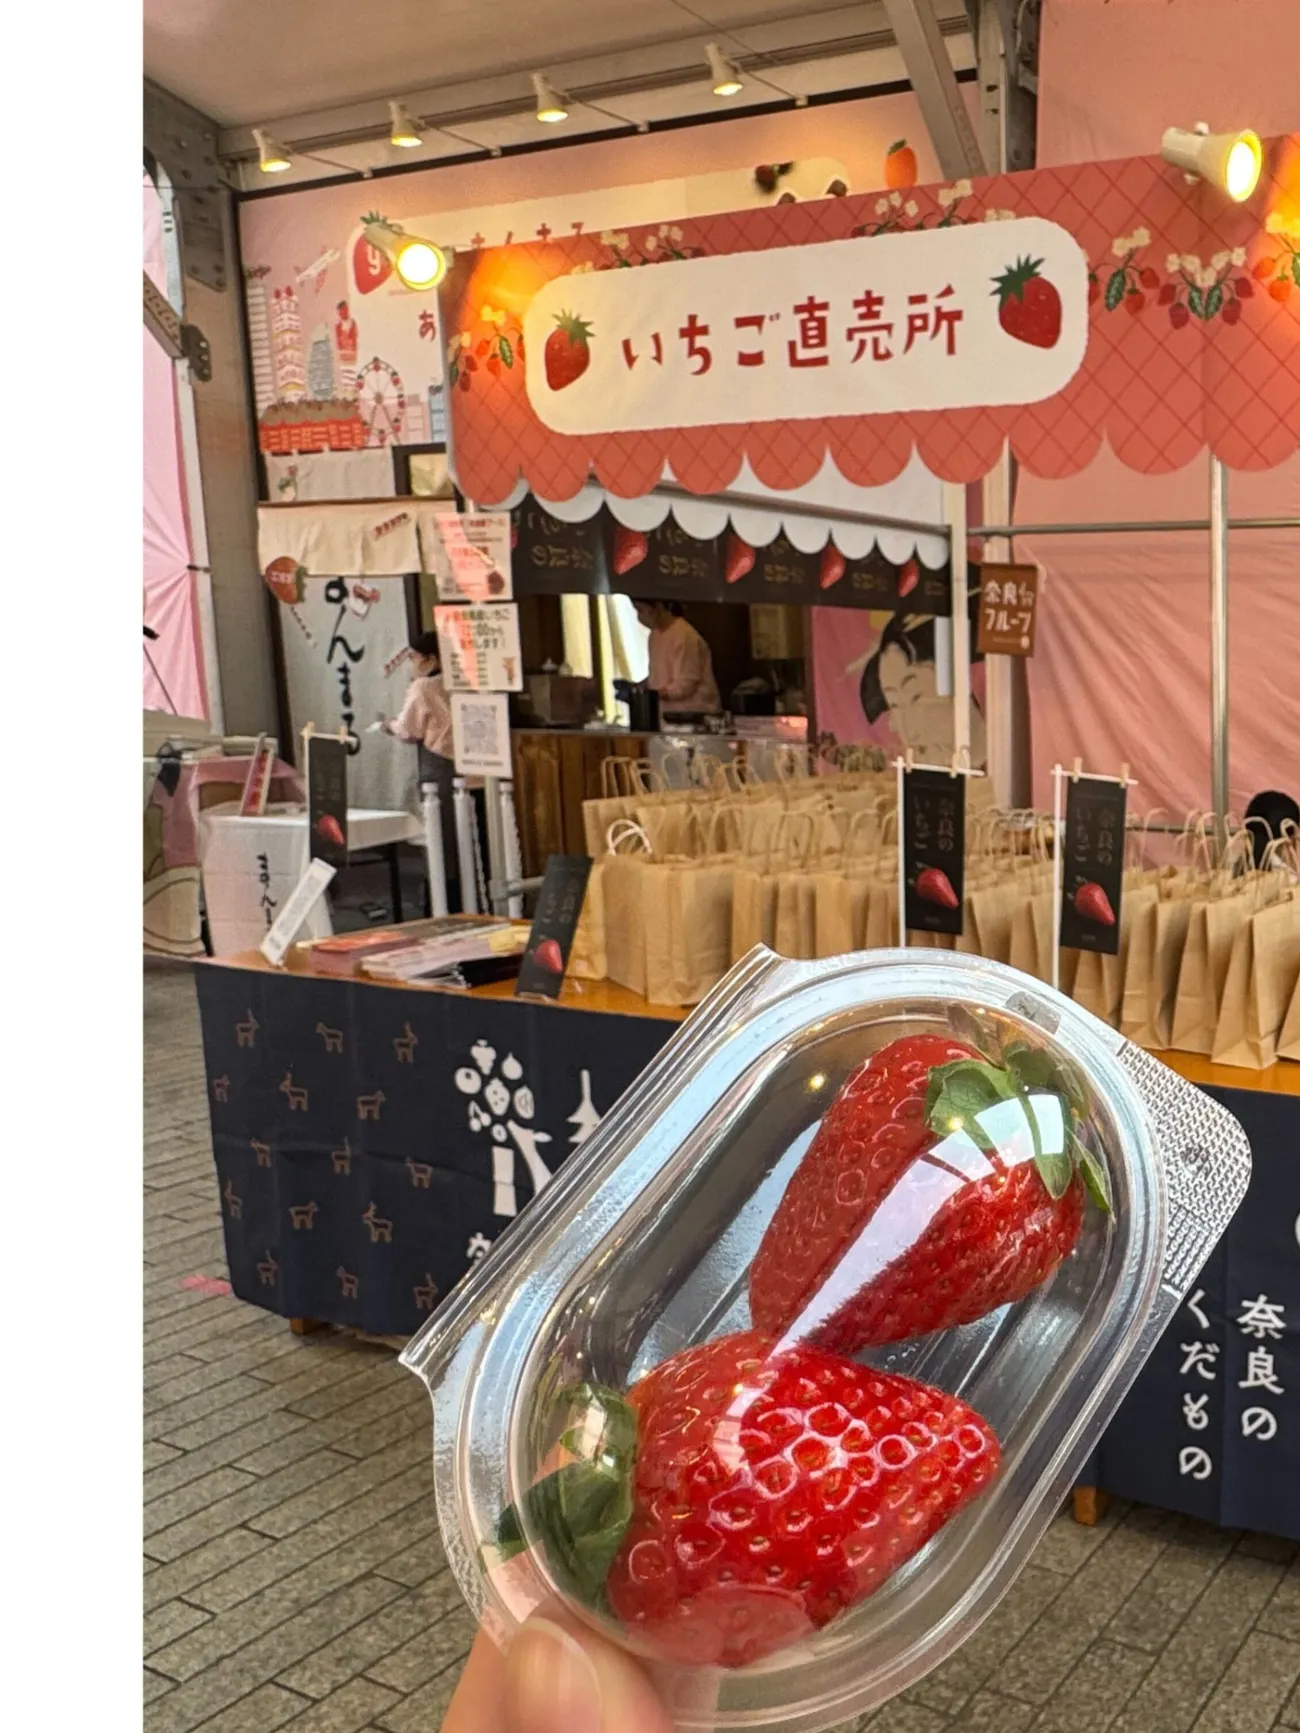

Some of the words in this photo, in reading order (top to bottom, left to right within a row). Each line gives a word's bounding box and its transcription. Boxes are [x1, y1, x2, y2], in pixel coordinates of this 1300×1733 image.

[418, 308, 437, 342] あ
[622, 283, 964, 376] いちご直売所
[984, 579, 1019, 606] 奈良
[984, 607, 1032, 634] フルーツ
[1178, 1288, 1221, 1480] くだもの
[1236, 1294, 1288, 1441] 奈良の
